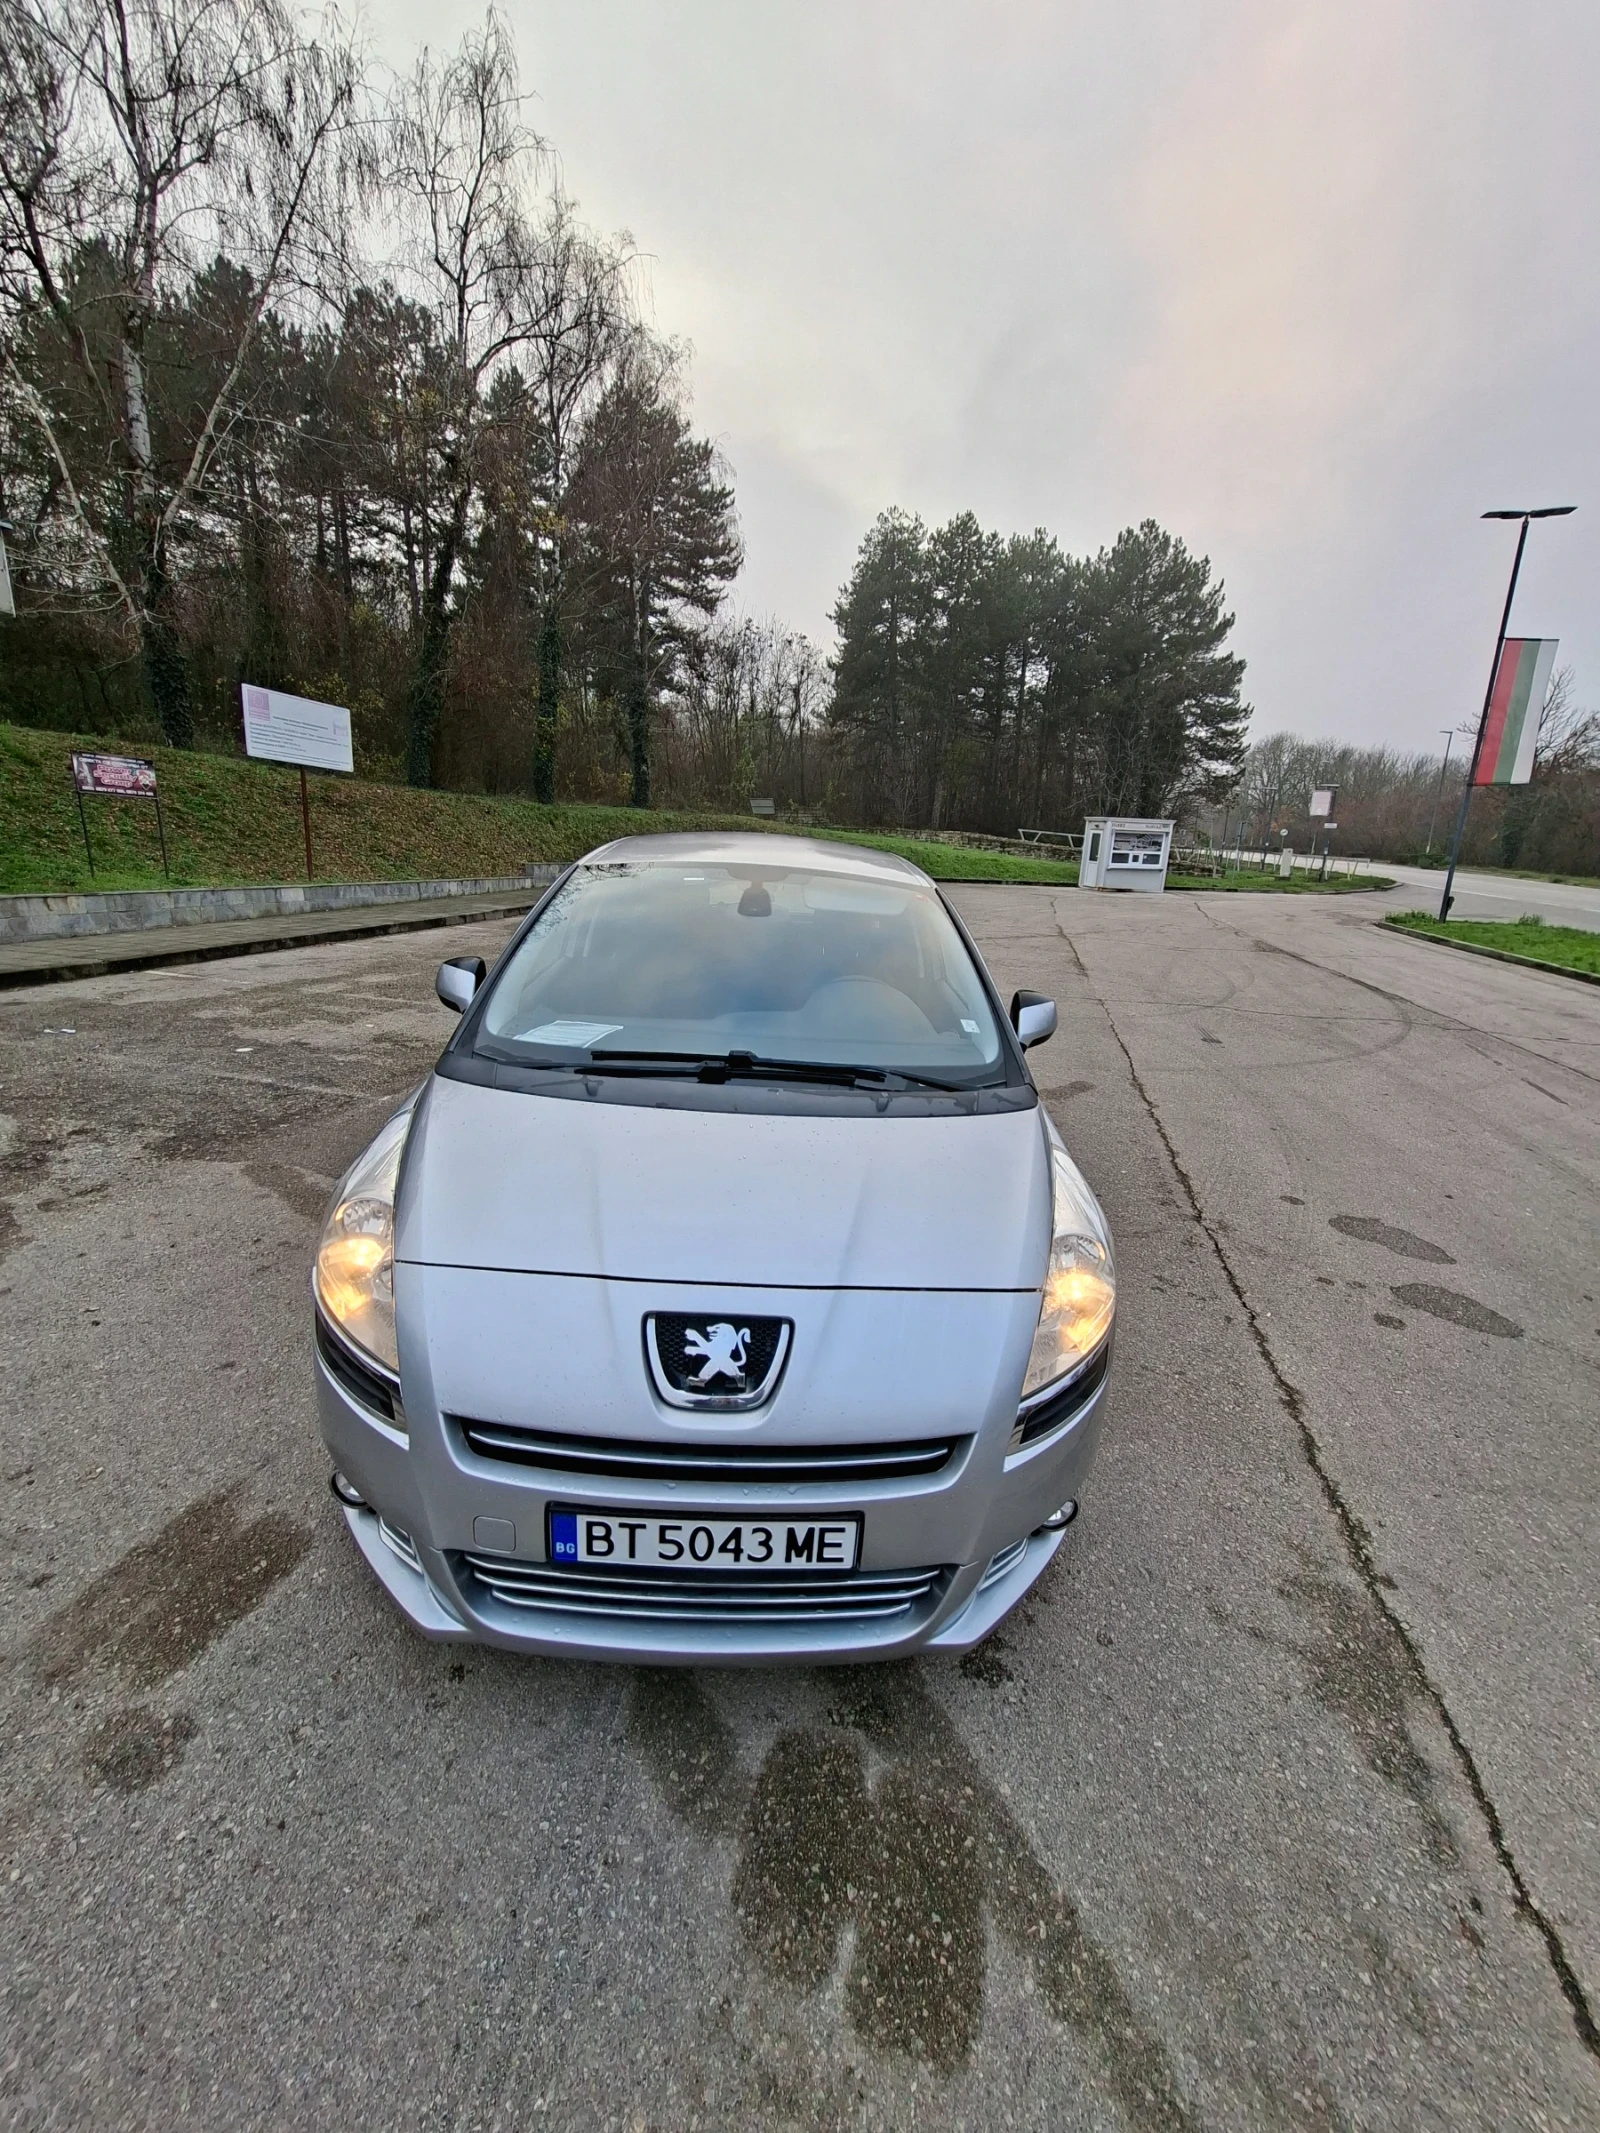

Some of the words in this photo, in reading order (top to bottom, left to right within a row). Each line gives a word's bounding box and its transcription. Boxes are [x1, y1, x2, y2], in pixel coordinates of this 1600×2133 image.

[93, 769, 138, 782] Security
[97, 764, 132, 775] Power
[101, 777, 133, 788] Group
[556, 1541, 575, 1554] BG
[586, 1520, 647, 1559] BT
[658, 1524, 774, 1563] 5043
[785, 1526, 846, 1563] ME
